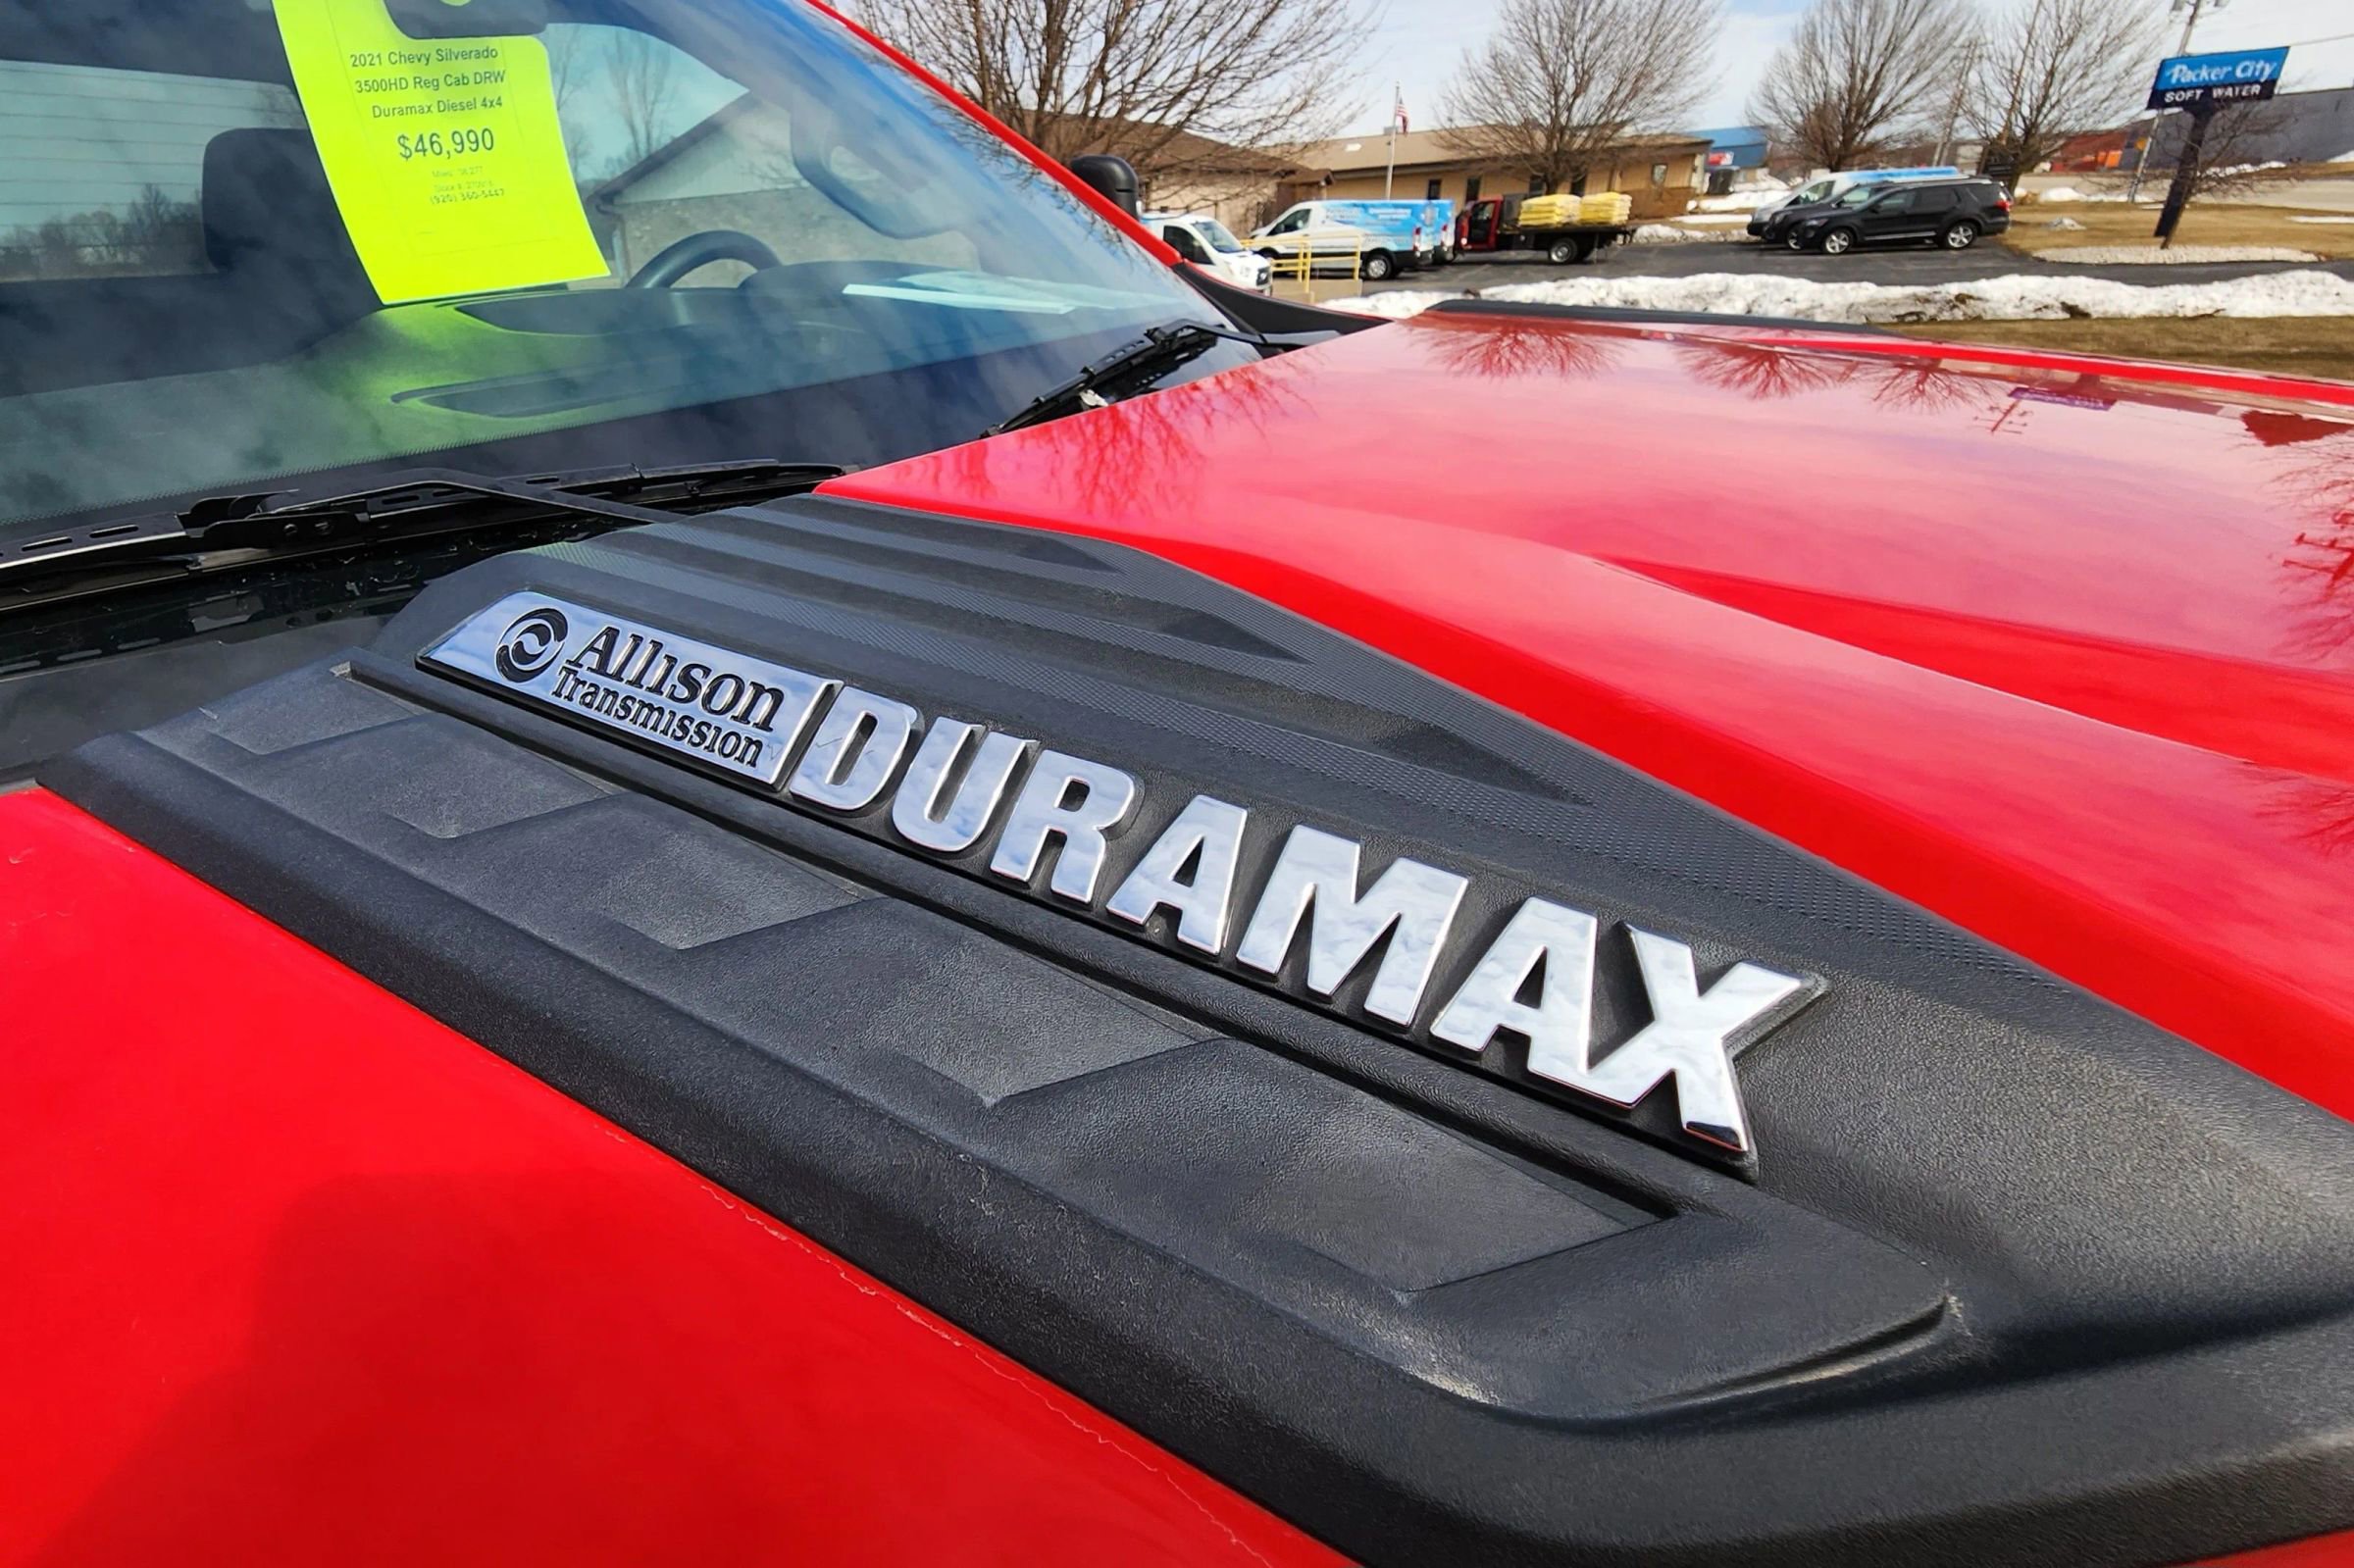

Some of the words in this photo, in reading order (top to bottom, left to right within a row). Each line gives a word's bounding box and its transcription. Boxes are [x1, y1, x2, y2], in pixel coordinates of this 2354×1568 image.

[350, 53, 383, 68] 2021
[387, 50, 431, 67] Chevy
[435, 46, 498, 63] Silverado
[355, 76, 409, 94] 3500HD
[413, 76, 440, 91] Reg
[443, 73, 470, 87] Cab
[474, 70, 507, 85] DRW
[2166, 62, 2232, 85] Packer
[2235, 59, 2277, 82] City
[2164, 88, 2205, 103] SOFT
[2212, 84, 2262, 99] WATER
[372, 103, 434, 119] Duramax
[437, 97, 478, 114] Diesel
[481, 96, 503, 110] 4x4
[397, 127, 494, 162] $46,990
[566, 626, 786, 732] Allison
[551, 665, 765, 769] Transmission
[787, 682, 1805, 1154] DURAMAX
